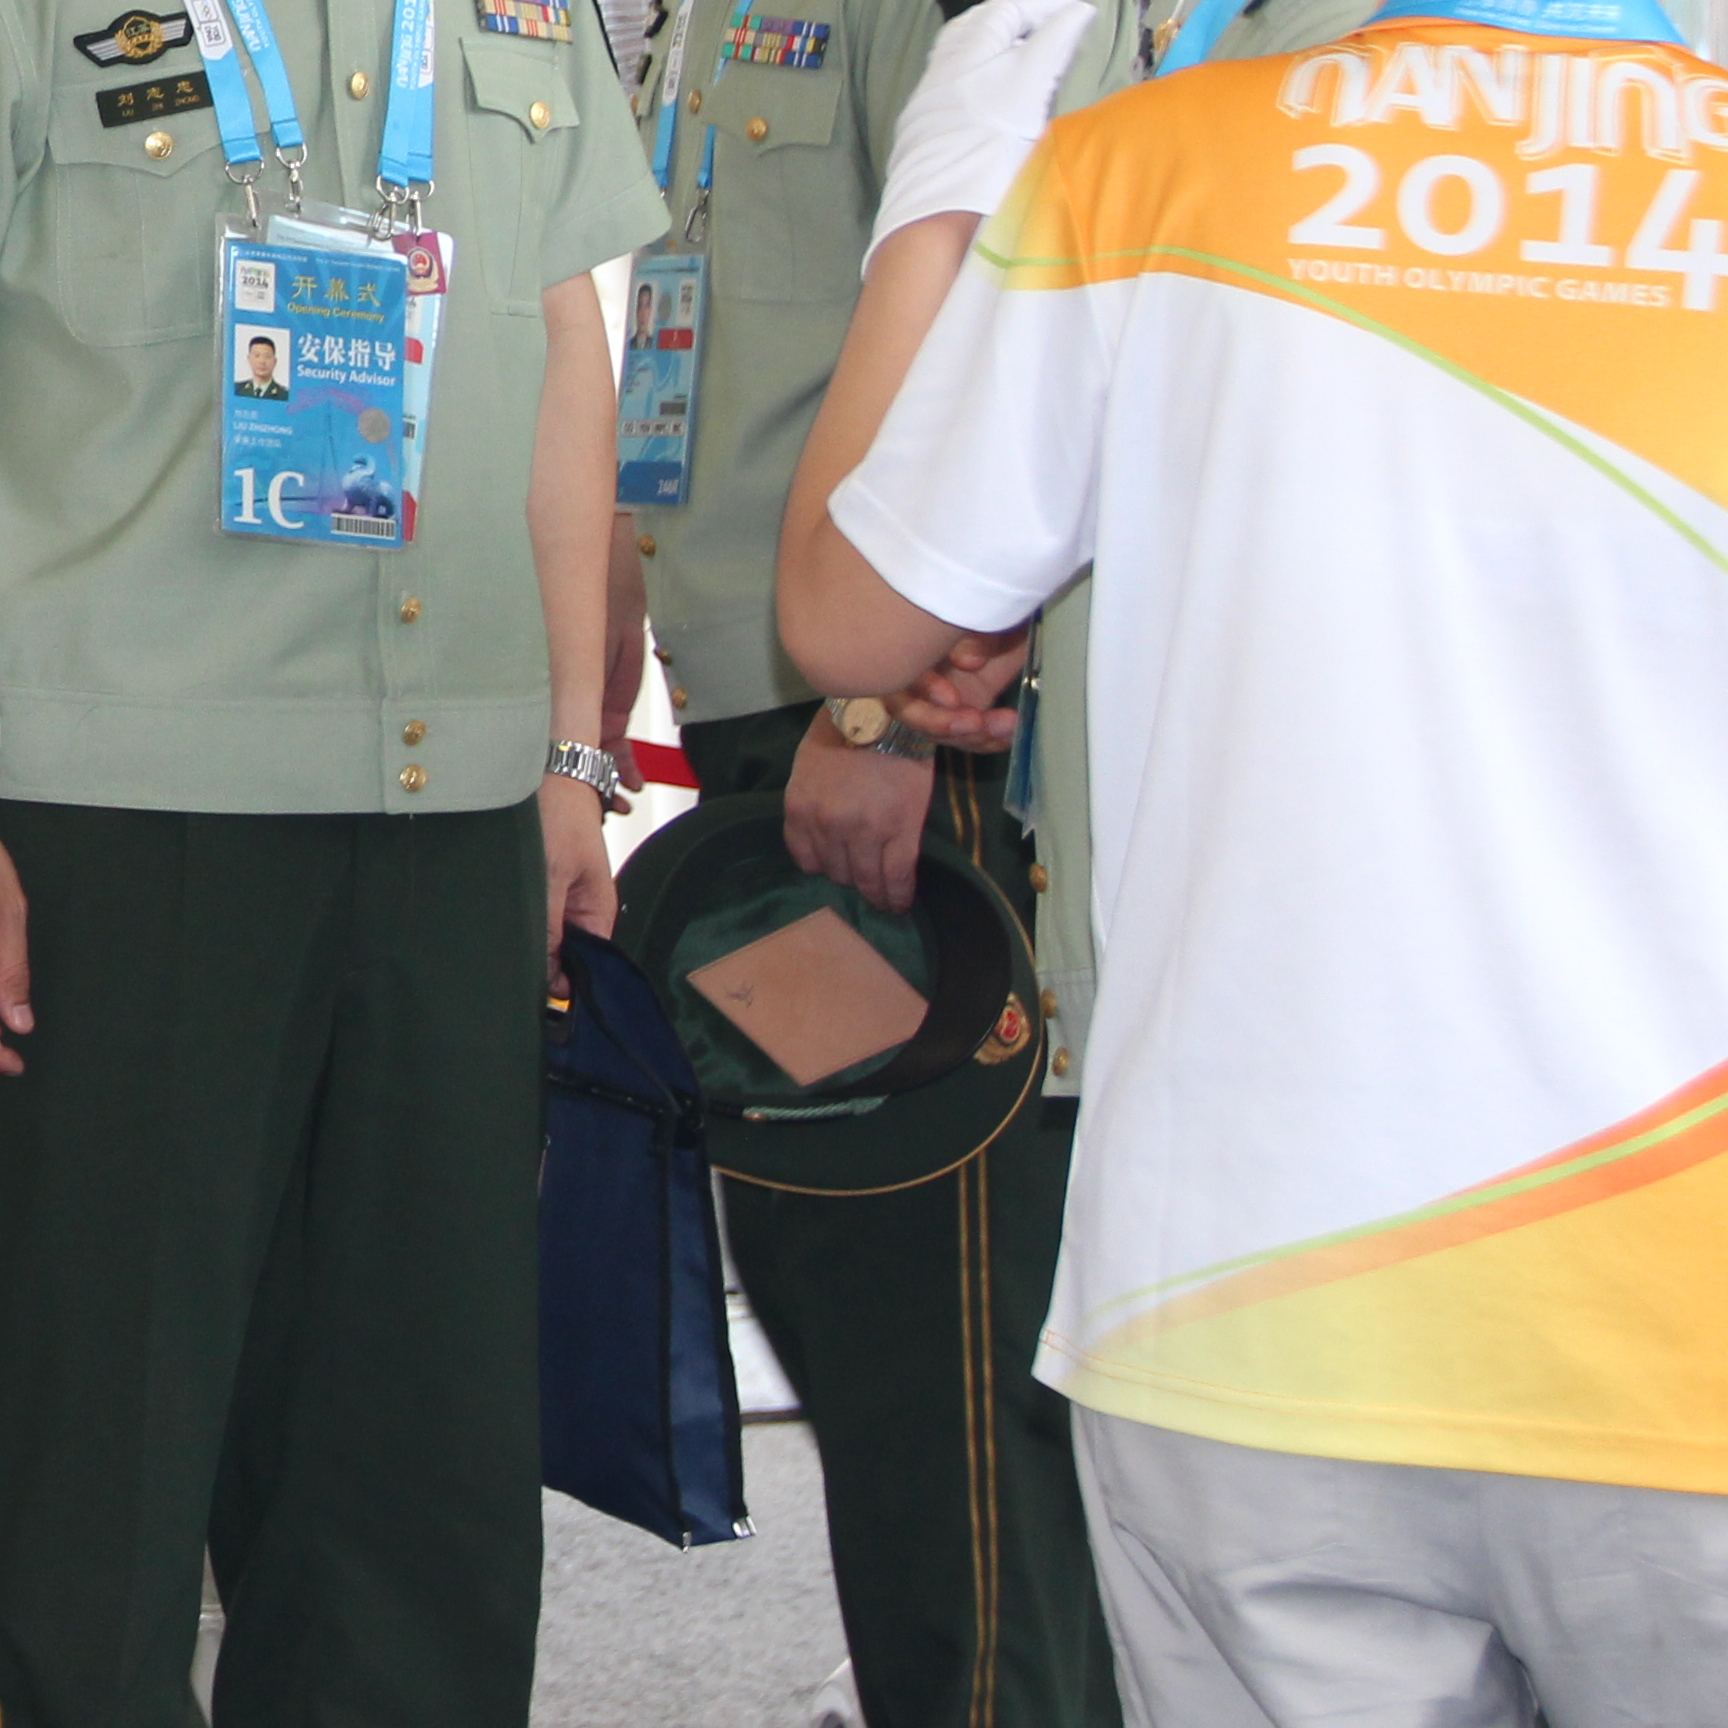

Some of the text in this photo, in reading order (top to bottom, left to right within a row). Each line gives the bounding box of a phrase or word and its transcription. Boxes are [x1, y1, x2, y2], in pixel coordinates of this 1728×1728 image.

[1288, 143, 1728, 312] 2014
[242, 275, 268, 288] 2014
[291, 275, 382, 308] 开幕式
[1287, 258, 1673, 308] YOUTH OLYMPIC GAMES
[287, 301, 385, 323] Opening Ceremony
[296, 333, 397, 371] 安保指导
[296, 364, 397, 388] Security Advisor
[232, 467, 305, 530] 1C
